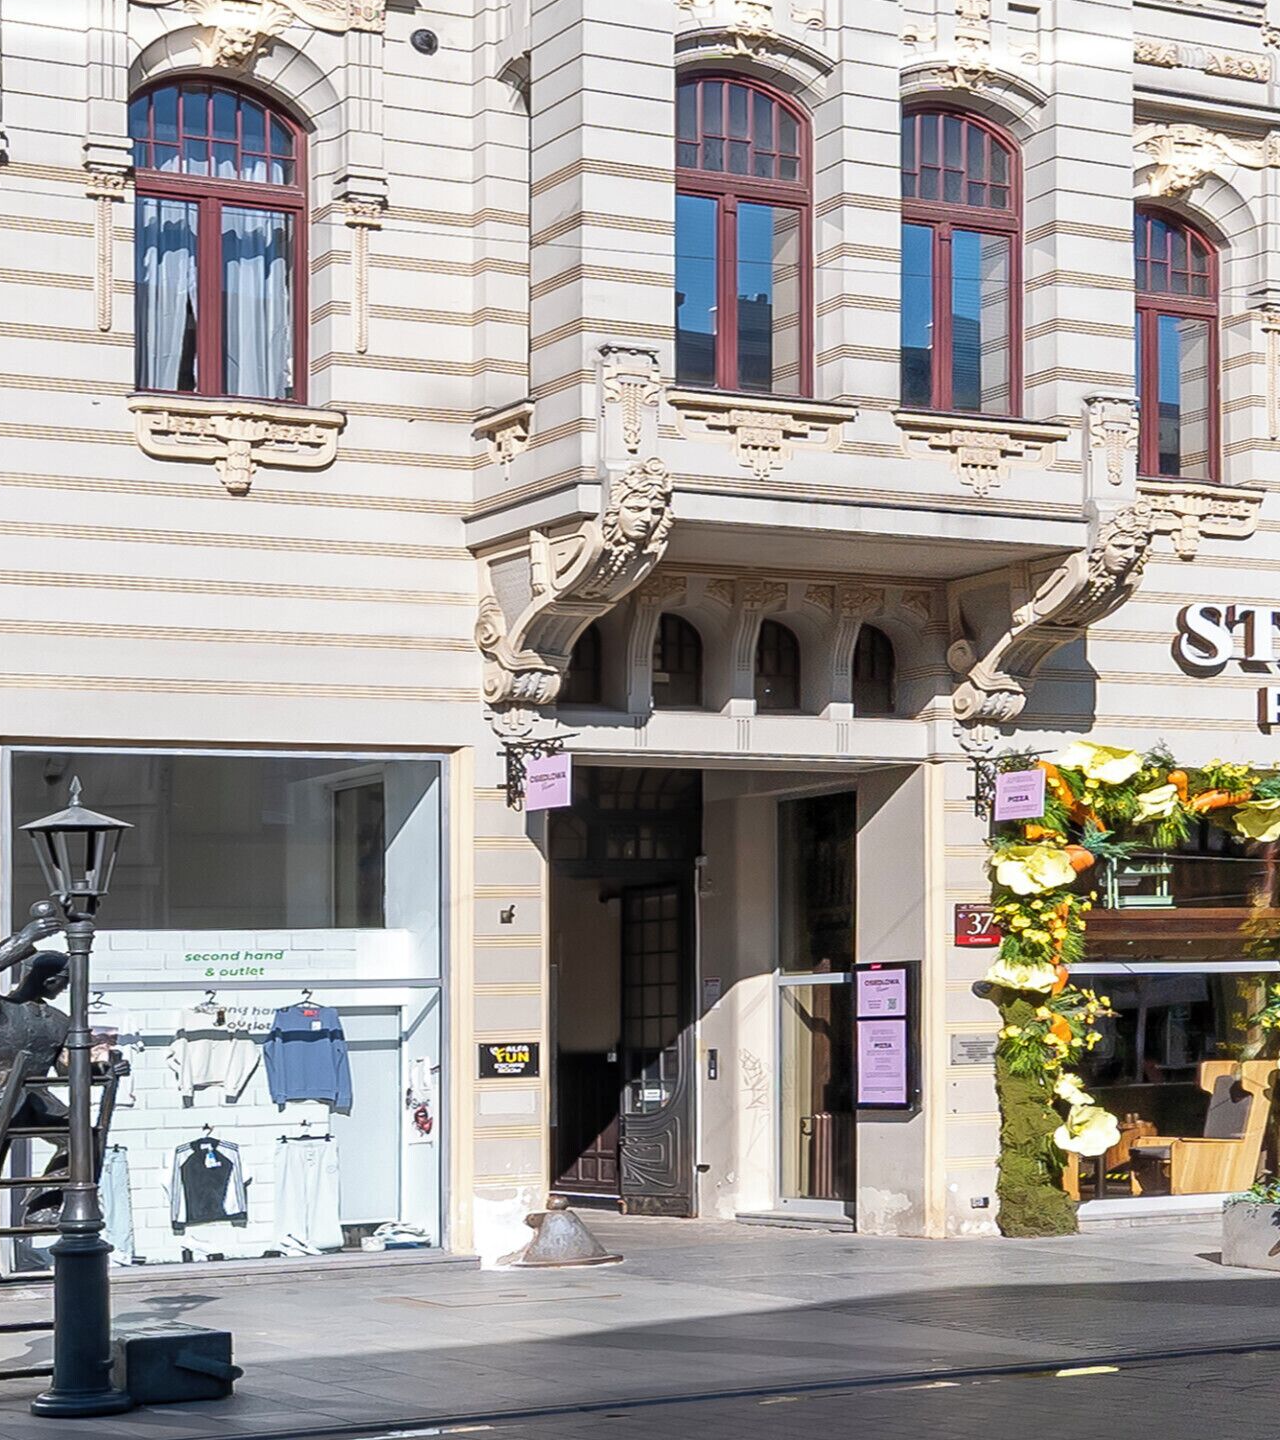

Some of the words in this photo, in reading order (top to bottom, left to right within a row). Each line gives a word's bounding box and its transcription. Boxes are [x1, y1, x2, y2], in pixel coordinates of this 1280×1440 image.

[966, 912, 994, 935] 37
[185, 951, 241, 962] second
[243, 950, 285, 961] hand
[205, 968, 215, 977] &
[220, 967, 265, 977] outlet
[495, 1047, 530, 1063] FUN
